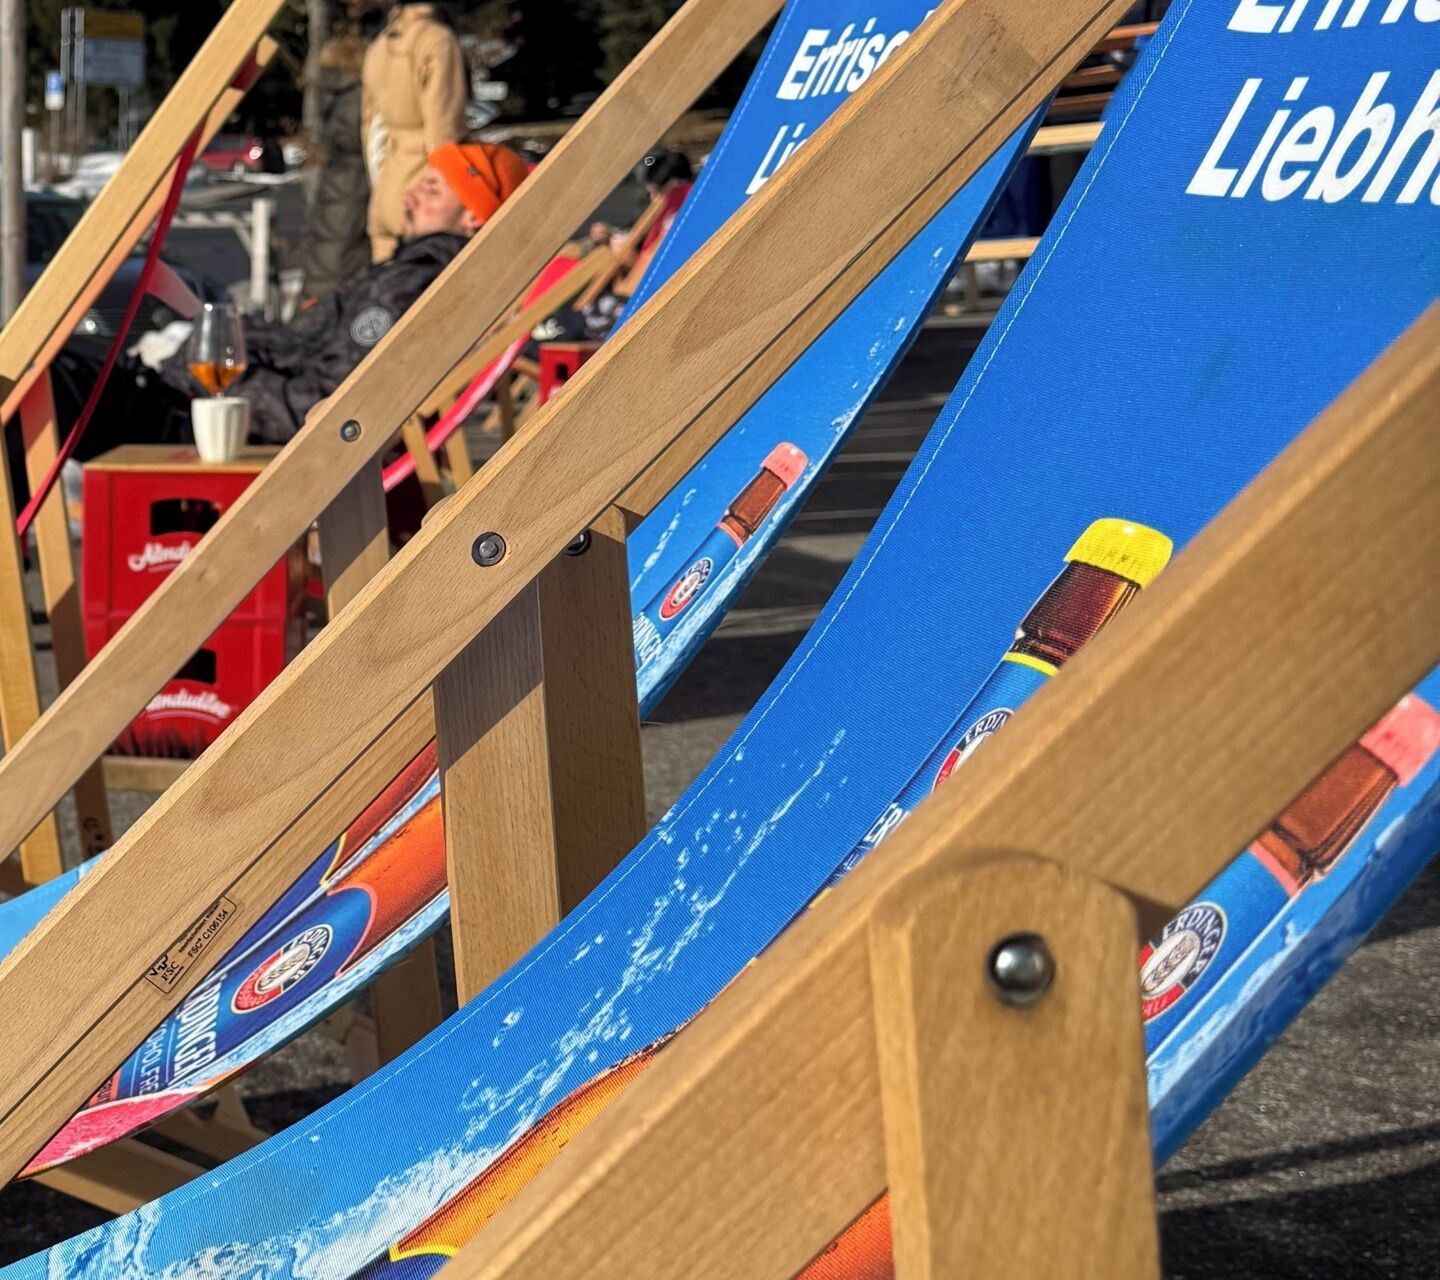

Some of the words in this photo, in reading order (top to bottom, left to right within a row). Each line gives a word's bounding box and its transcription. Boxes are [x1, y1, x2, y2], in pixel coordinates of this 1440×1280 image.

[776, 10, 935, 100] Erfrisc
[745, 122, 808, 195] Li
[1185, 70, 1440, 204] Liebh
